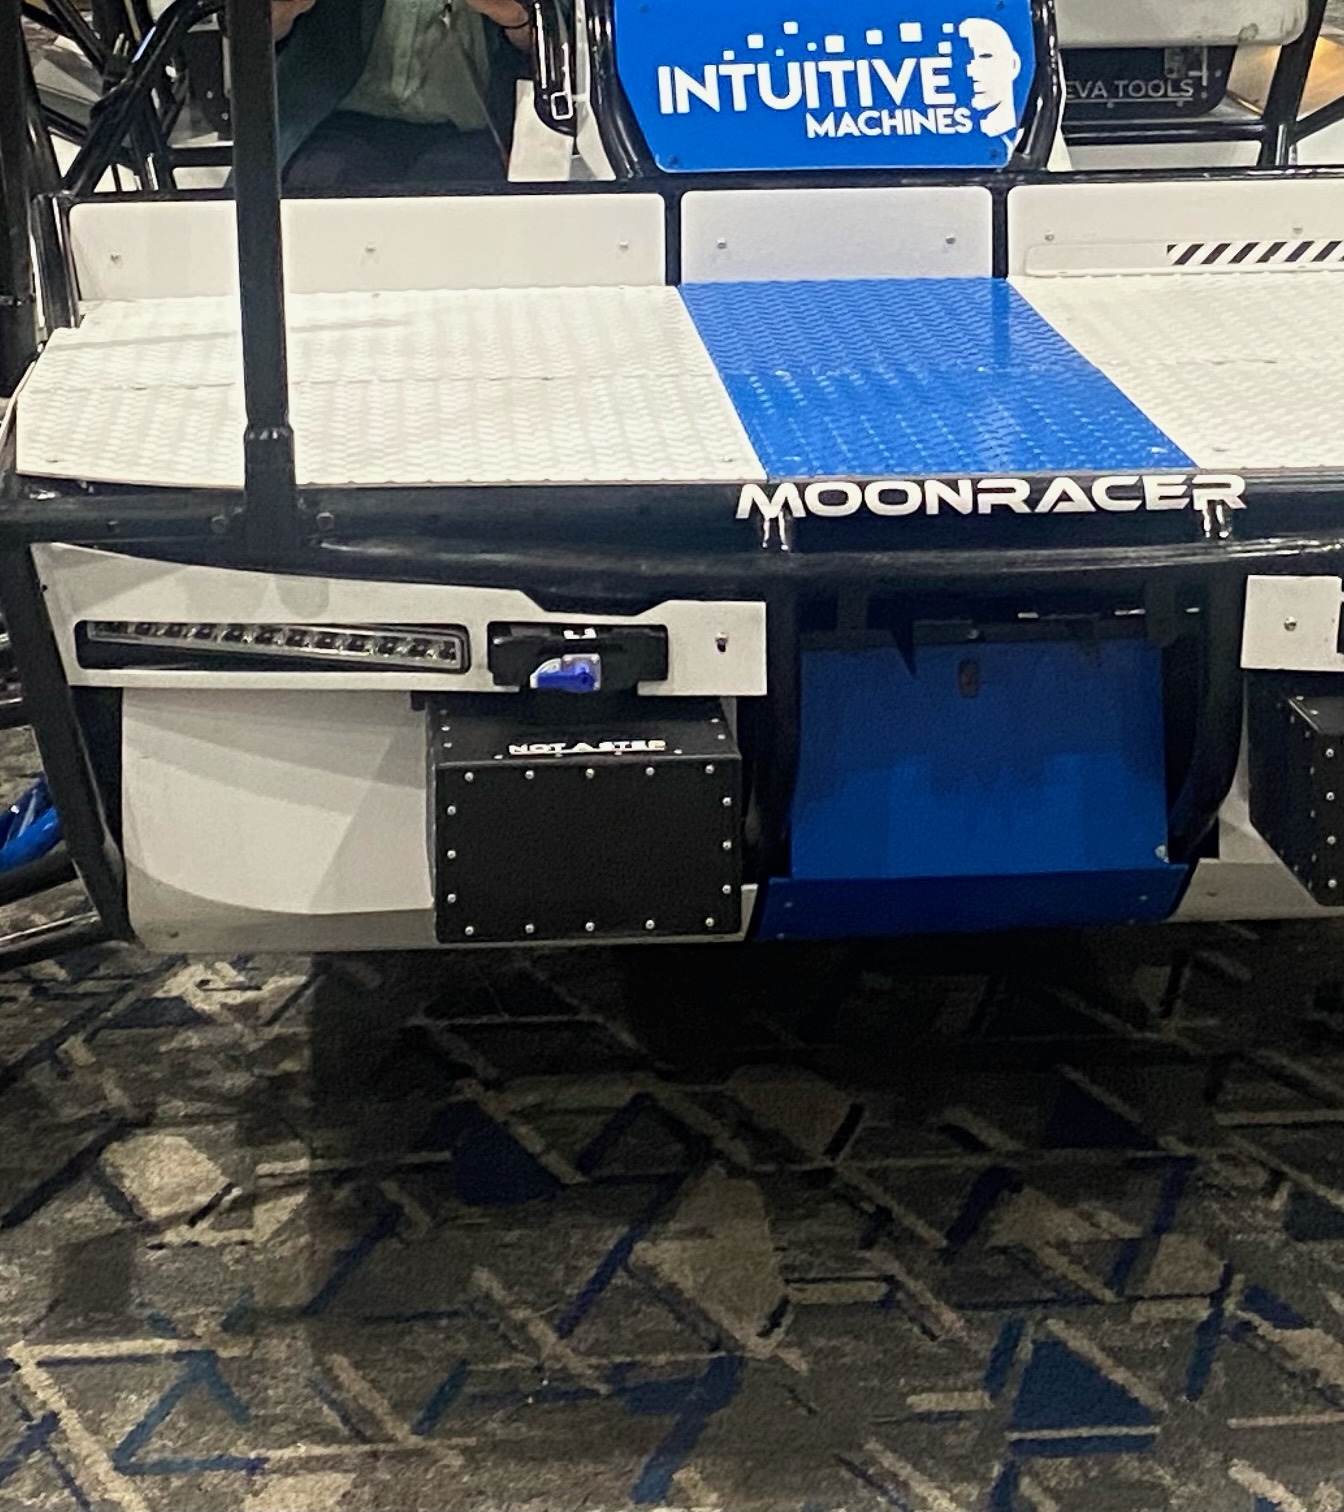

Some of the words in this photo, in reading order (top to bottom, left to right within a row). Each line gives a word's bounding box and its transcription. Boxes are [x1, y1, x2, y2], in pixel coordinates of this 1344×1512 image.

[657, 56, 957, 115] INTUITIVE
[1064, 80, 1108, 99] EVA
[1113, 79, 1194, 98] TOOLS
[806, 107, 973, 139] MACHINES
[735, 473, 1247, 519] MOONRACER
[508, 743, 566, 755] NOT
[571, 742, 596, 753] A
[598, 740, 666, 752] STEP
